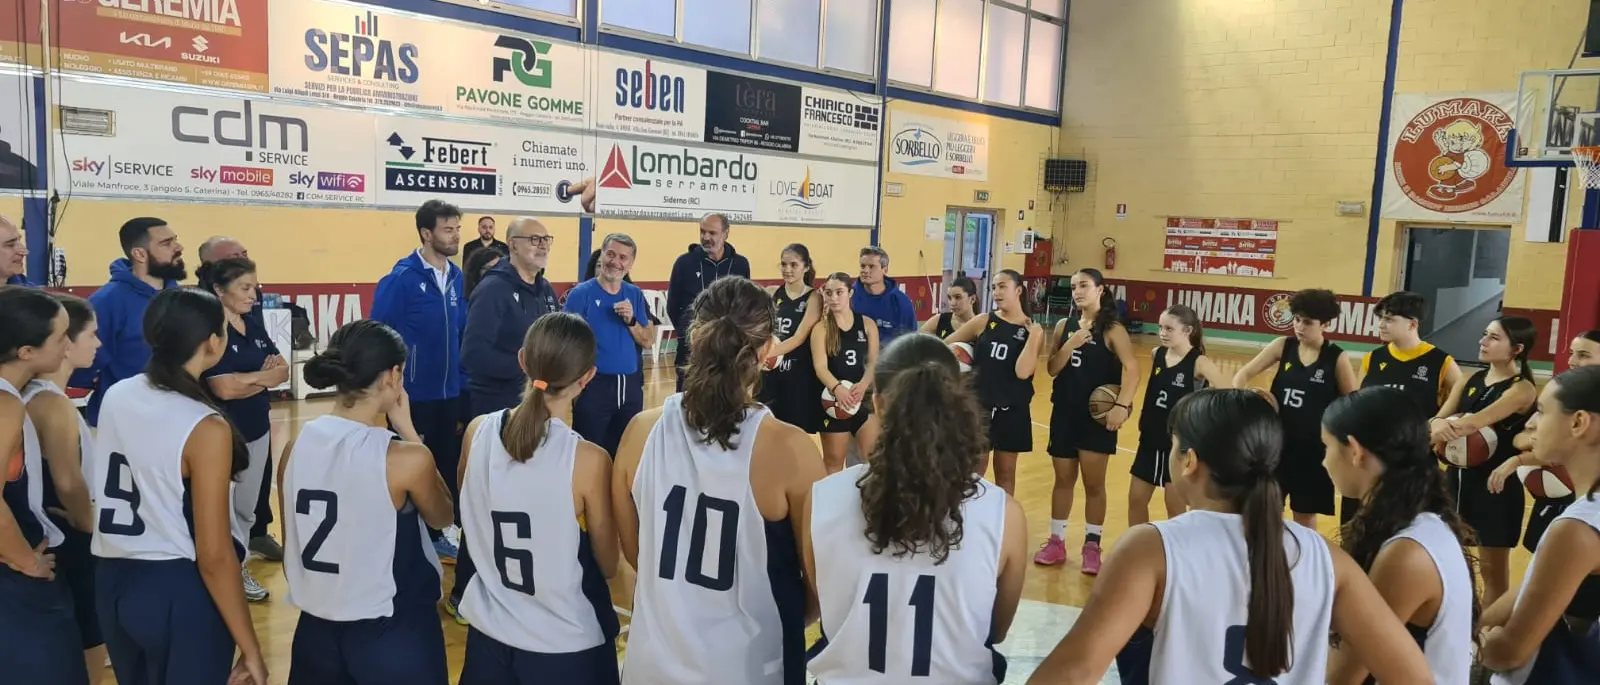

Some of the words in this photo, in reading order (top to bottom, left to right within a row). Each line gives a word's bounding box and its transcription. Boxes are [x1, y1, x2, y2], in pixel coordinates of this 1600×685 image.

[97, 0, 242, 26] EMIA
[181, 52, 220, 64] SUZUKI
[304, 28, 419, 84] SEPAS
[616, 59, 685, 113] seben
[456, 86, 522, 108] PAVONE
[527, 95, 583, 115] GOMME
[805, 95, 853, 114] CHIRICO
[172, 100, 308, 152] cdm
[804, 108, 853, 127] FRANCESCO
[1400, 100, 1515, 144] LUMAKA
[422, 137, 492, 166] Febert
[522, 140, 578, 156] Chiamate
[895, 137, 940, 159] SORBELLO
[72, 157, 105, 176] sky
[114, 161, 174, 177] SERVICE
[259, 152, 308, 166] SERVICE
[513, 154, 517, 166] i
[520, 157, 563, 170] numeri
[565, 161, 589, 172] uno.
[632, 145, 757, 186] Lombardo
[190, 165, 217, 183] sky
[222, 169, 271, 185] mobile
[289, 171, 315, 188] sky
[320, 174, 346, 189] wifi
[395, 173, 485, 191] ASCENSORI
[73, 180, 95, 188] Viale
[151, 184, 183, 194] (angolo
[193, 186, 230, 196] Caterina)
[656, 178, 755, 194] serramenti
[769, 180, 798, 196] LOVE
[808, 182, 834, 198] BOAT
[663, 196, 688, 204] Siderno
[775, 316, 792, 334] 12
[845, 349, 857, 366] 3
[990, 341, 1009, 360] 10
[1155, 390, 1168, 409] 2
[1283, 388, 1305, 408] 15
[99, 451, 146, 537] 9
[295, 488, 340, 575] 2
[658, 484, 740, 592] 10
[490, 510, 535, 597] 6
[862, 572, 936, 677] 11
